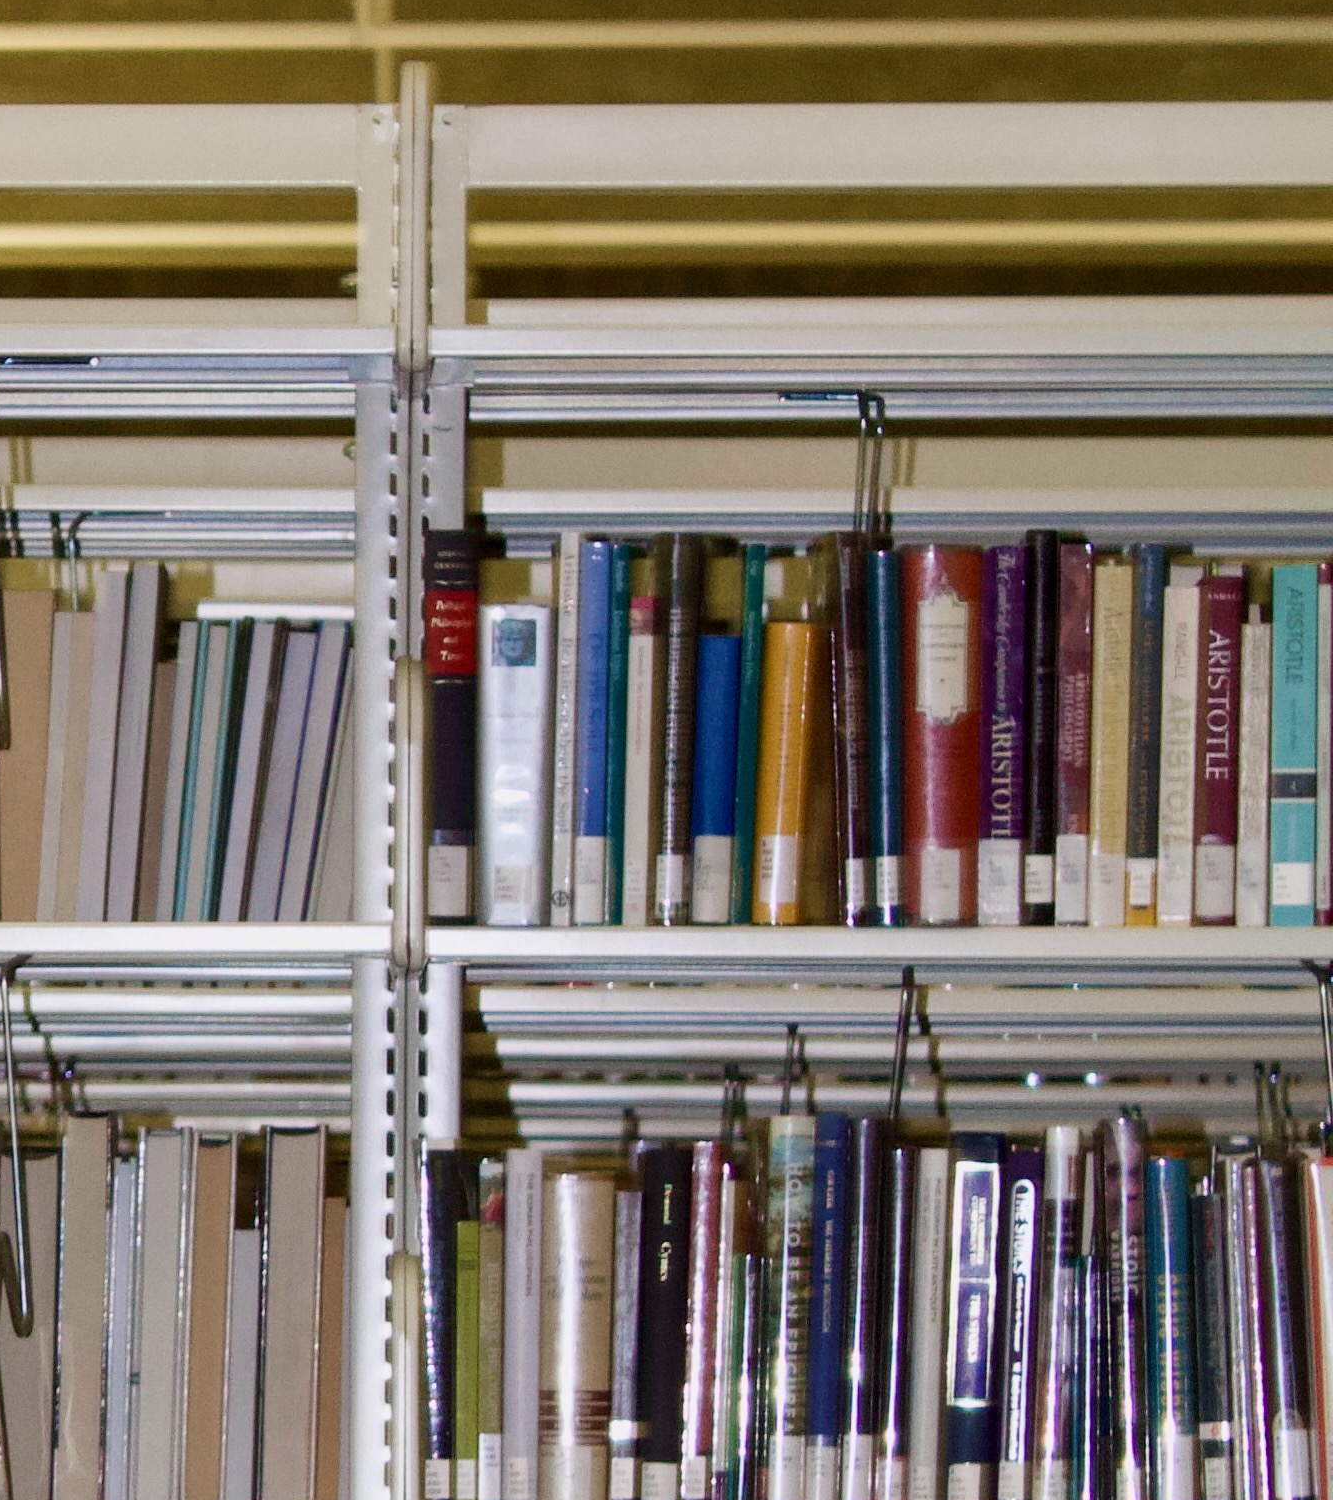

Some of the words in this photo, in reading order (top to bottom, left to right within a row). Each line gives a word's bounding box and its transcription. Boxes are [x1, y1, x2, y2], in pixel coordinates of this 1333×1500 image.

[1284, 587, 1304, 685] ARISTOTLE
[1205, 630, 1231, 780] ARISTOTLE
[1014, 1191, 1029, 1221] THE
[1012, 1223, 1029, 1275] STOICS
